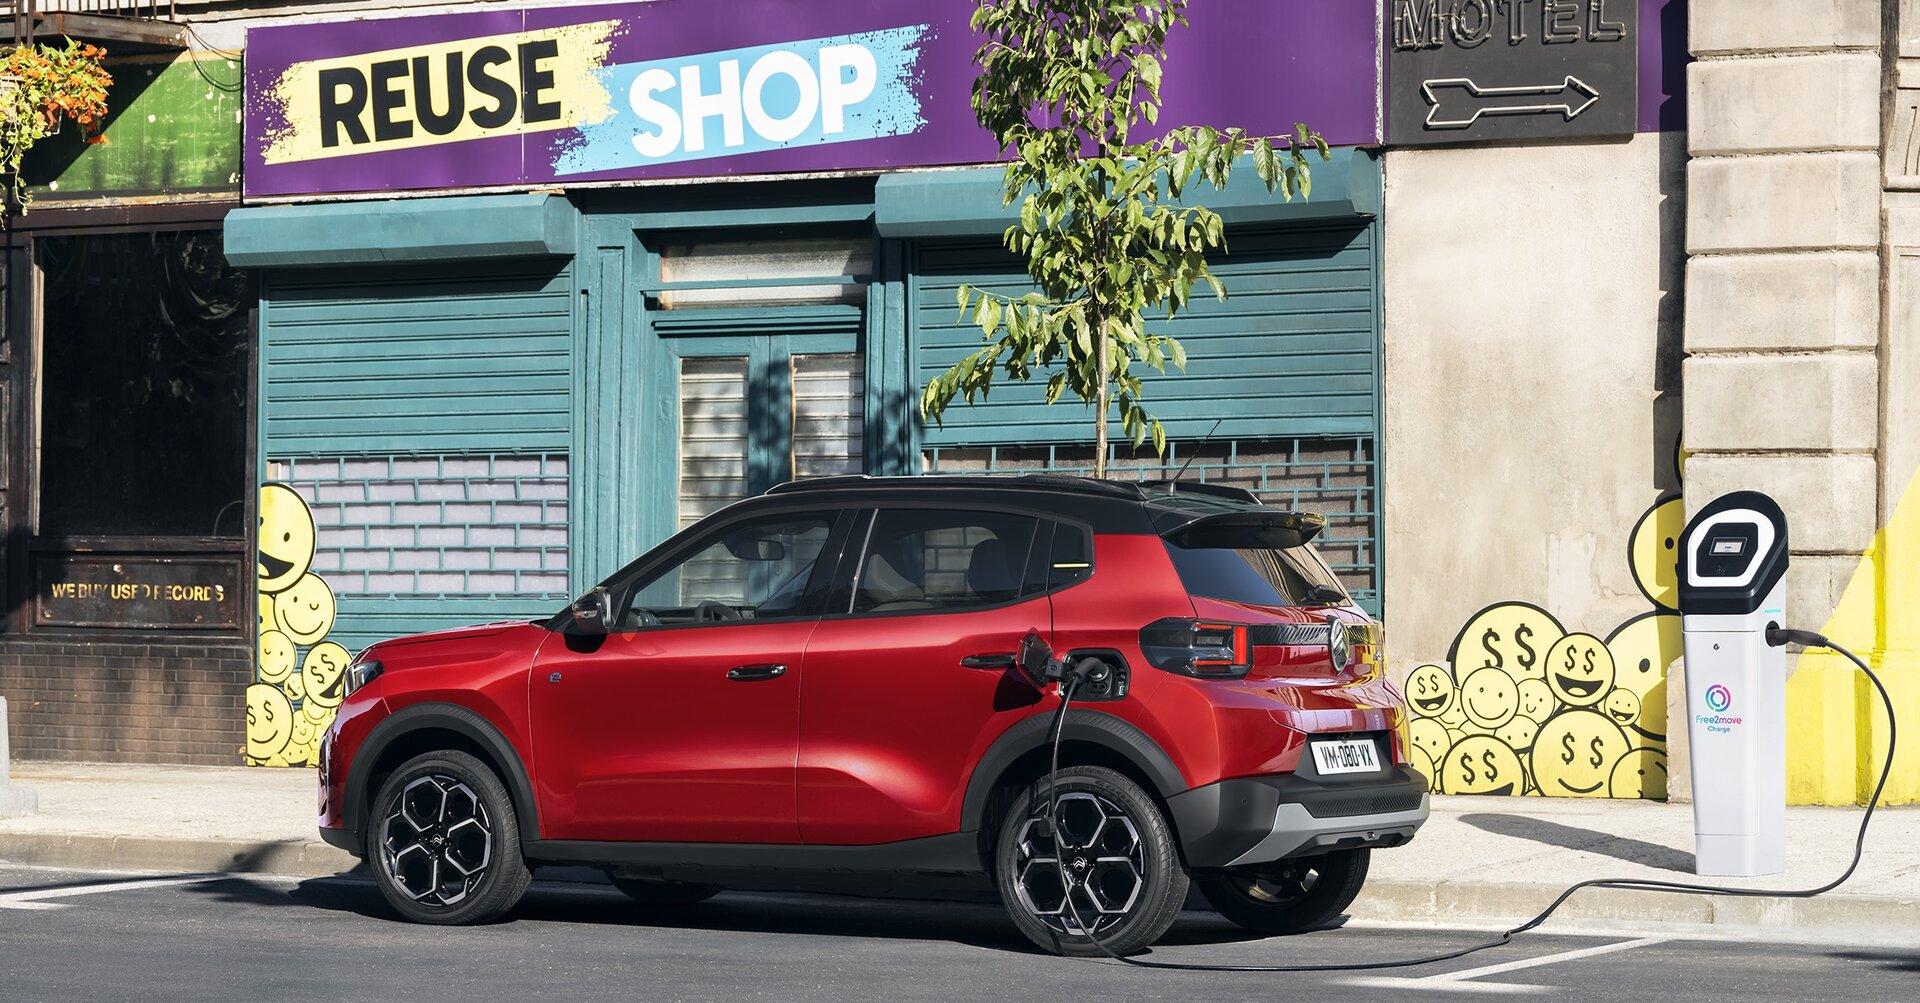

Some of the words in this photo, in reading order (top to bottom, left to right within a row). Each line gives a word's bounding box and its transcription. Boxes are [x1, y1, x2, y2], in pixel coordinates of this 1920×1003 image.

[1391, 0, 1627, 49] MOTEL
[319, 38, 562, 148] REUSE
[628, 43, 877, 158] SHOP
[52, 583, 75, 598] WE
[1696, 715, 1742, 724] Free2move
[1707, 725, 1730, 733] Charge
[1320, 744, 1374, 769] VM-080-VX
